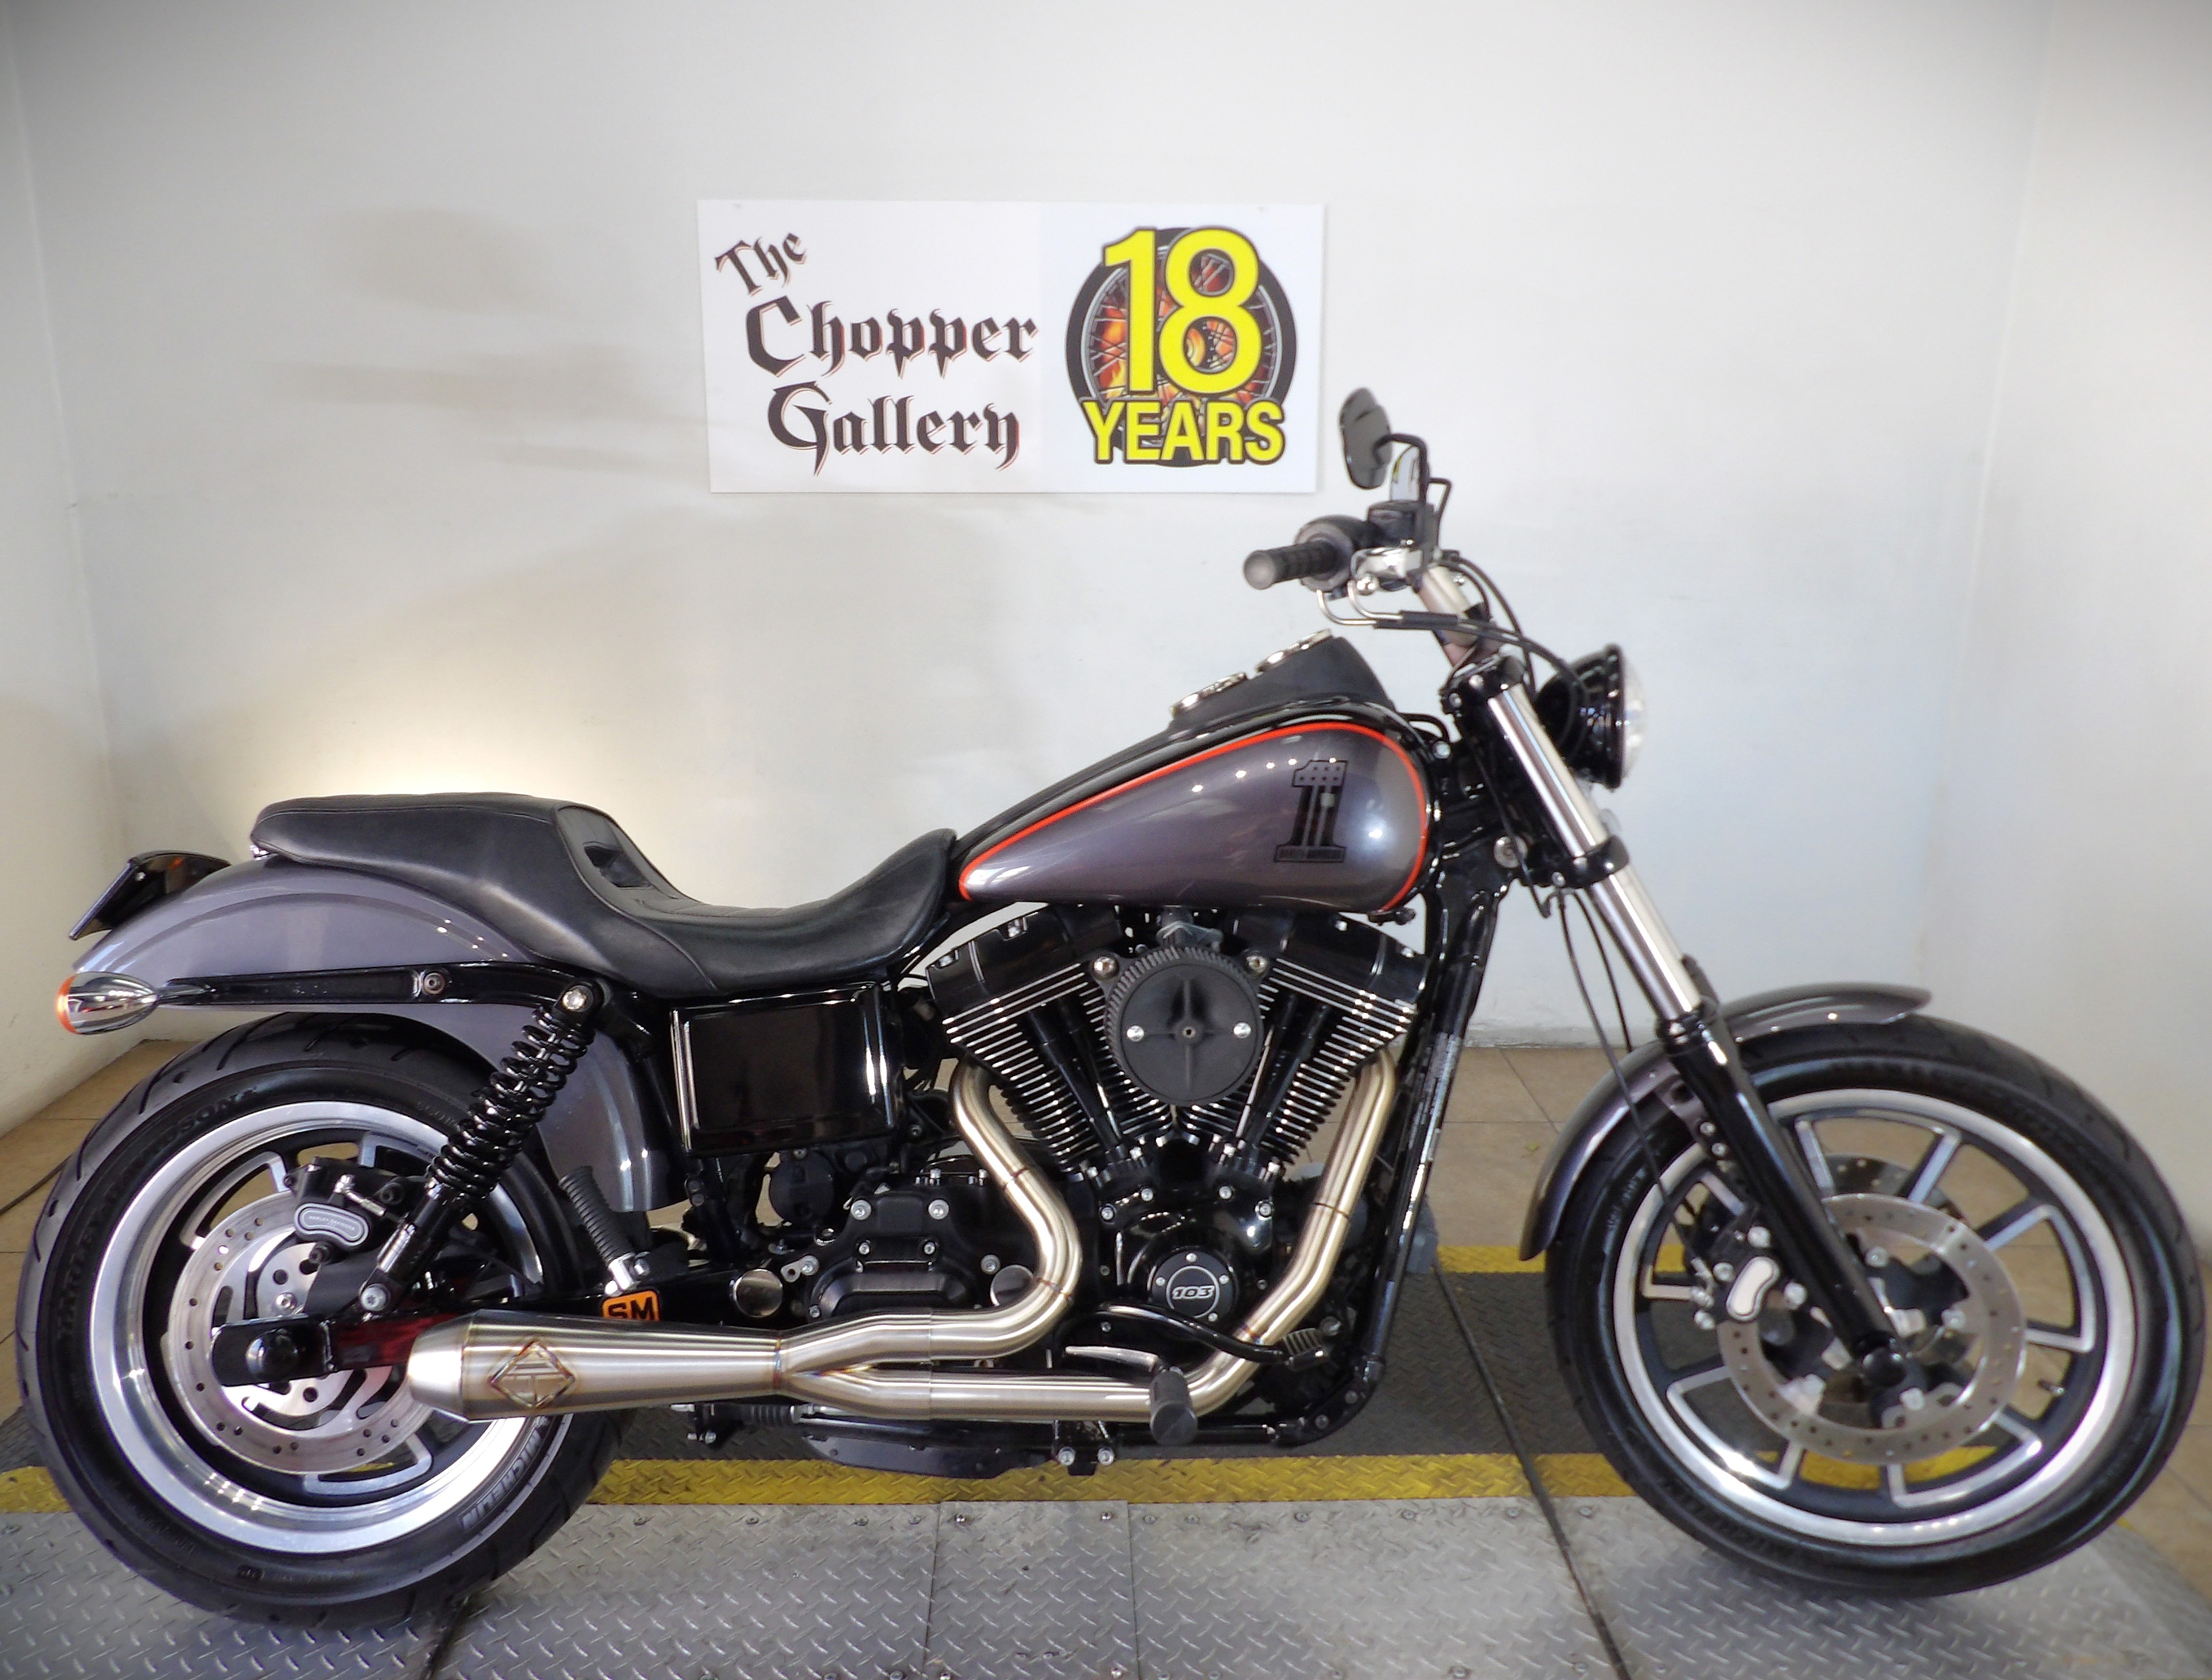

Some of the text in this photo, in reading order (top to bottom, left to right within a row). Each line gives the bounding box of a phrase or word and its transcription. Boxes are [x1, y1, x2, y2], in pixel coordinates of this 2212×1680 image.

[714, 233, 807, 296] The
[745, 295, 1038, 379] Chopper
[1103, 227, 1261, 395] 18
[767, 381, 1020, 477] Gallery
[1080, 401, 1285, 464] YEARS
[608, 1296, 655, 1320] SM
[1172, 1285, 1215, 1300] 103
[462, 1427, 543, 1530] MICHELIN
